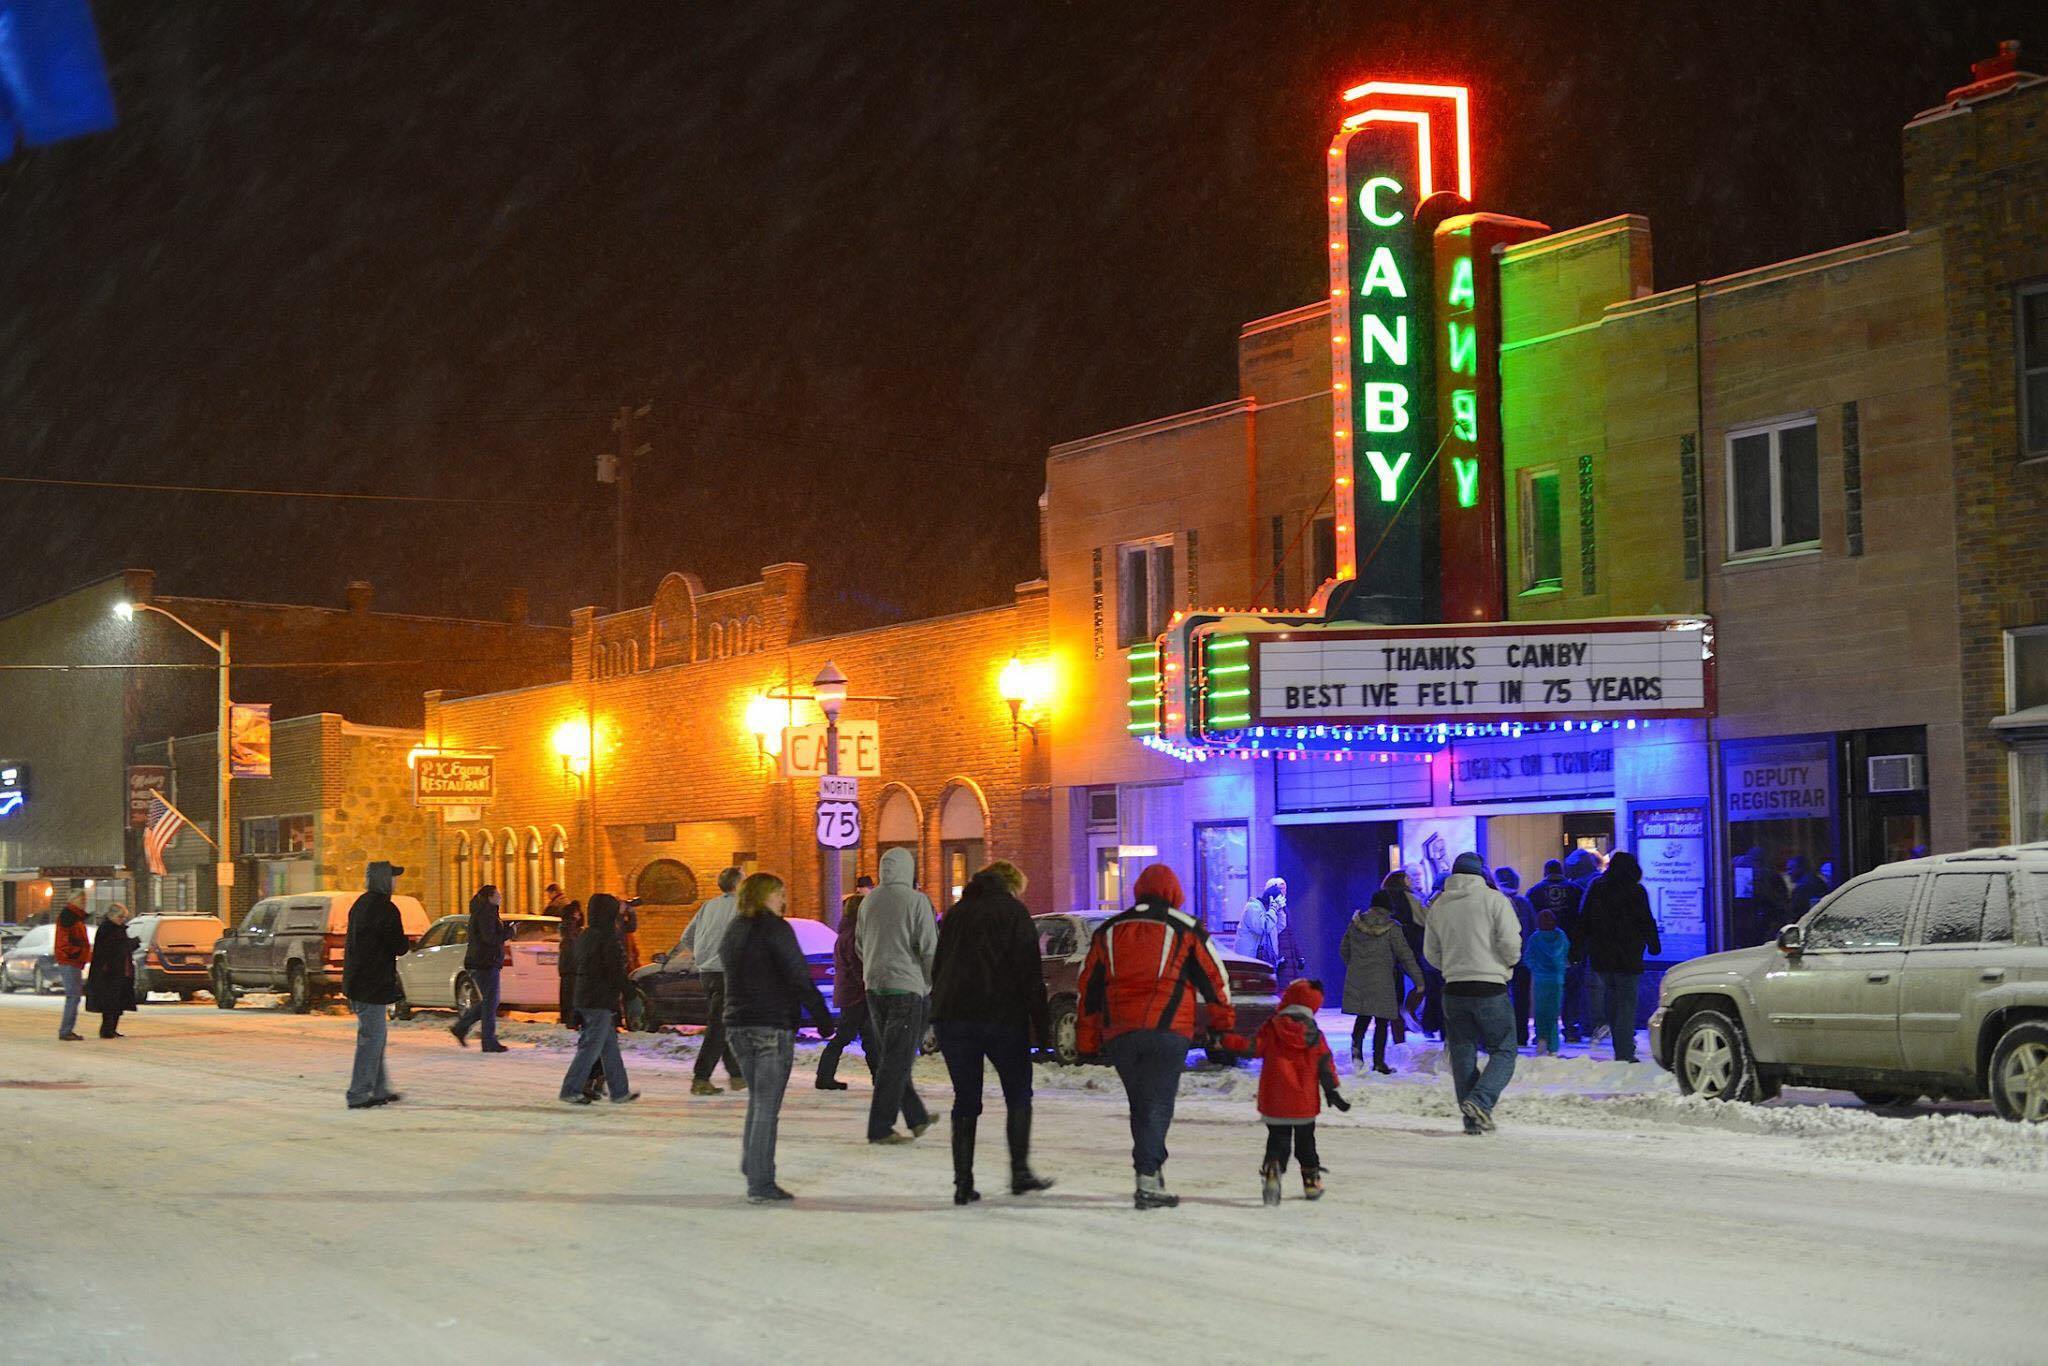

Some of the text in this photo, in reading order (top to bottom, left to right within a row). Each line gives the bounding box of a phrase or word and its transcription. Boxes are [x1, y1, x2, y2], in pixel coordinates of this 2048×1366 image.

[1358, 176, 1412, 504] CANBY
[1382, 642, 1587, 671] THANKS CANBY
[1286, 676, 1663, 709] BEST IVE FELT IN 75 YEARS
[420, 775, 491, 792] RESTAURANT
[823, 780, 857, 795] NORTH
[1743, 766, 1809, 788] DEPUTY
[1730, 789, 1825, 811] REGISTRAR
[821, 812, 855, 838] 75
